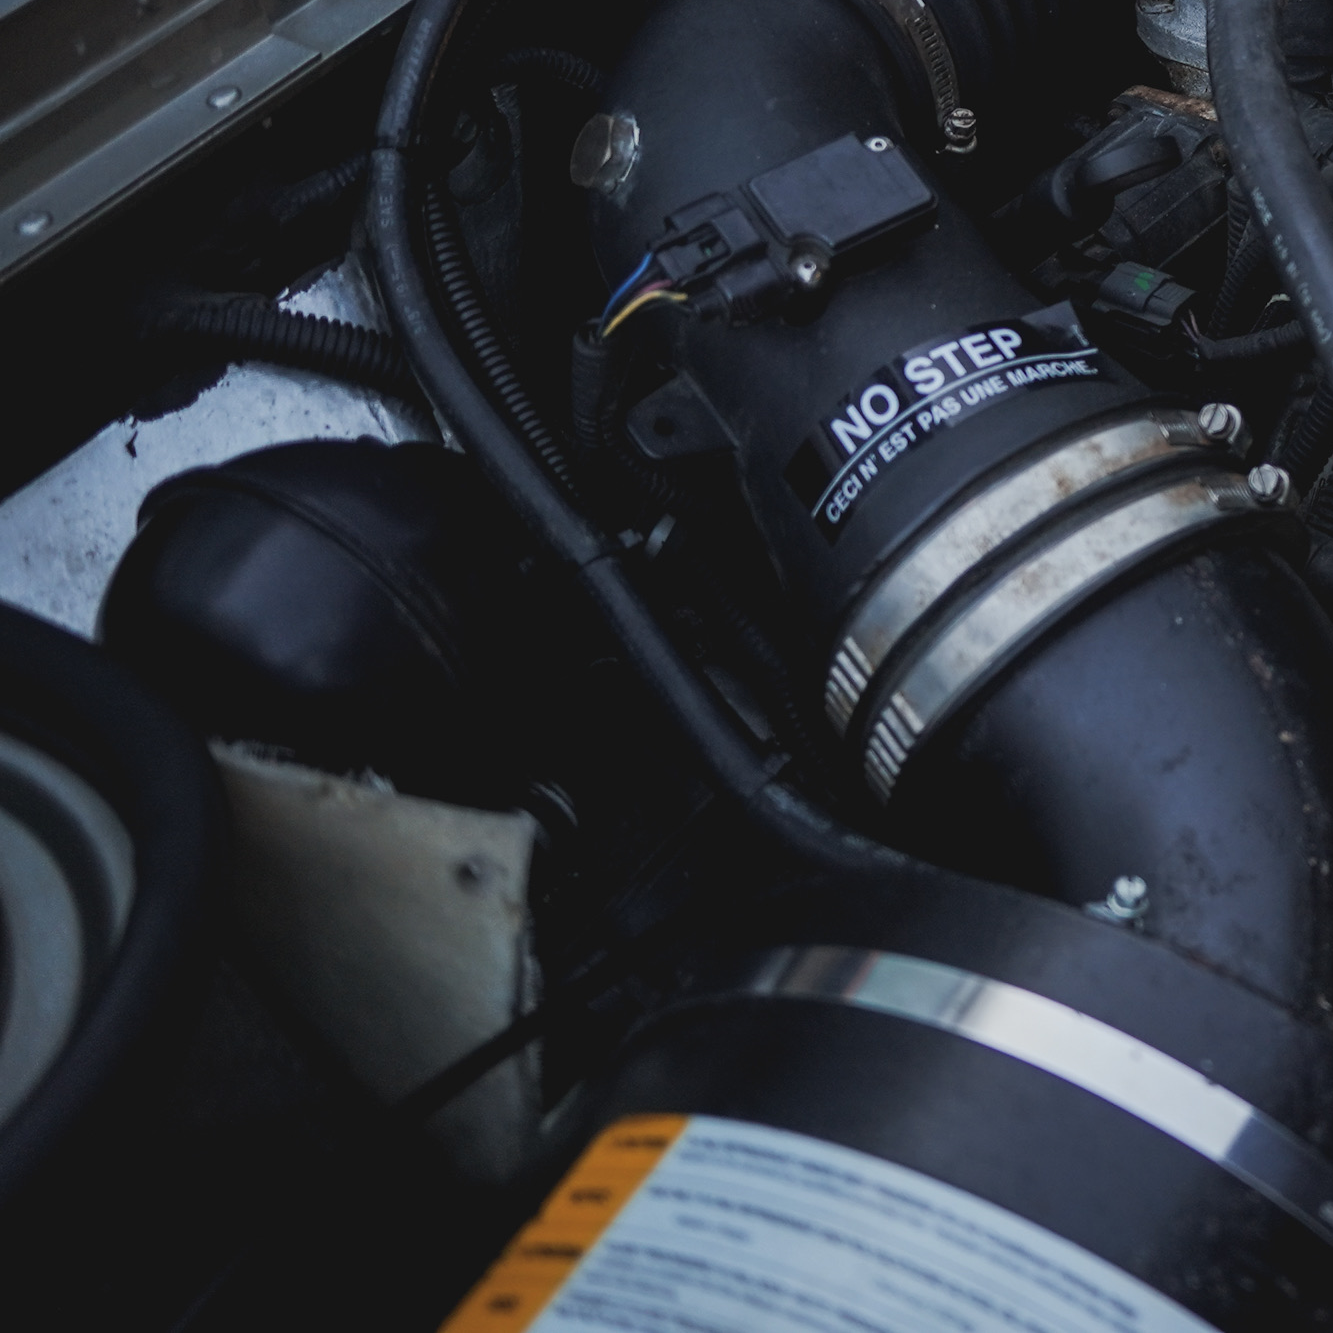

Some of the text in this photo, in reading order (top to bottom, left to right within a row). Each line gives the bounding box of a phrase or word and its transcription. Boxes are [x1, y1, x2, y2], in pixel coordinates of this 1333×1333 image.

[379, 193, 395, 229] SAE
[825, 472, 864, 524] CECI
[877, 421, 918, 463] EST
[916, 395, 962, 433] PAS
[959, 375, 1009, 407] UNE
[830, 327, 1023, 455] NO STEP
